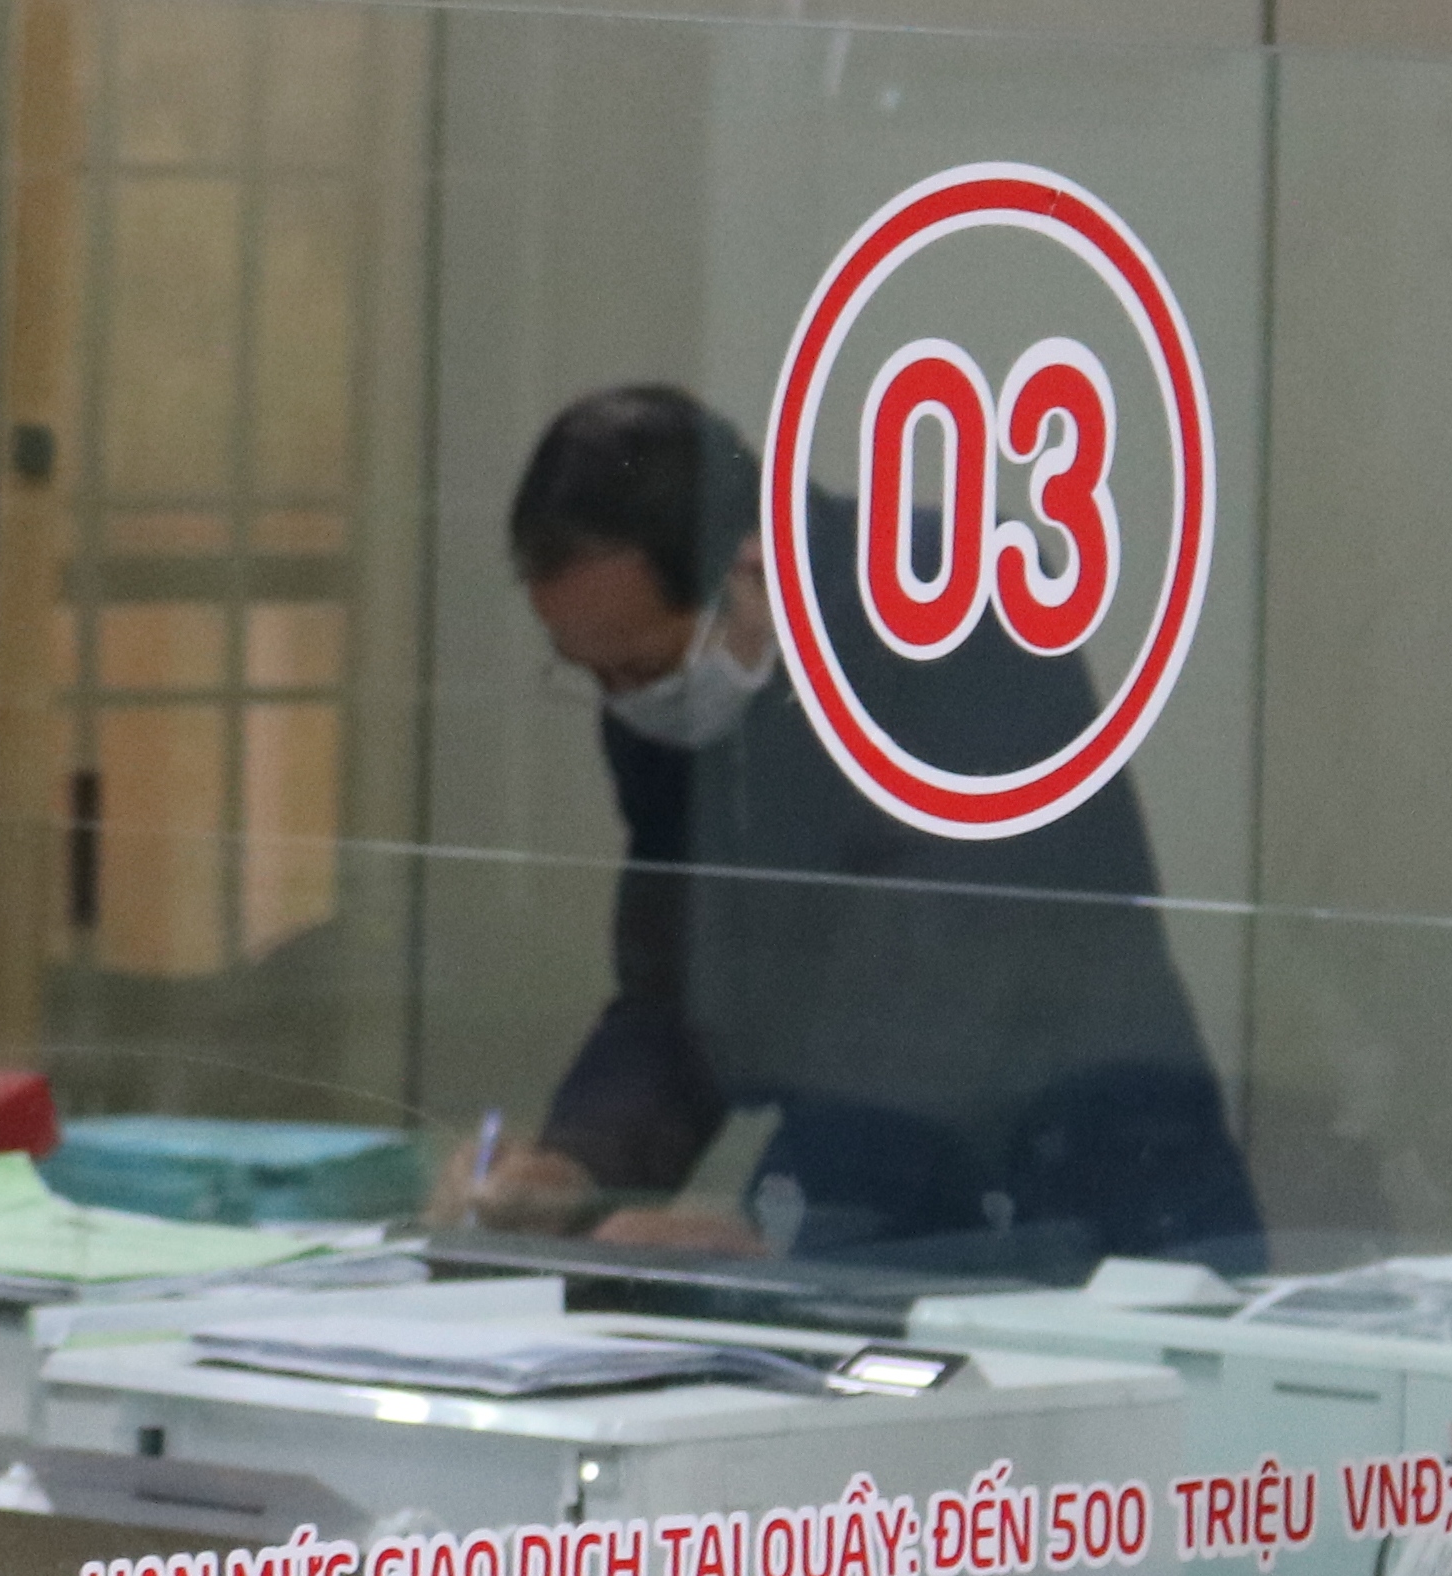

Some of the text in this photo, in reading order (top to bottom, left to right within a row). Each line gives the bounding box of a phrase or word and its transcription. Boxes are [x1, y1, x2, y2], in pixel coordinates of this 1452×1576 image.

[862, 344, 1116, 656] 03
[930, 1466, 1034, 1571] ĐẾN
[1049, 1486, 1148, 1564] 500
[1174, 1459, 1317, 1563] TRIỆU
